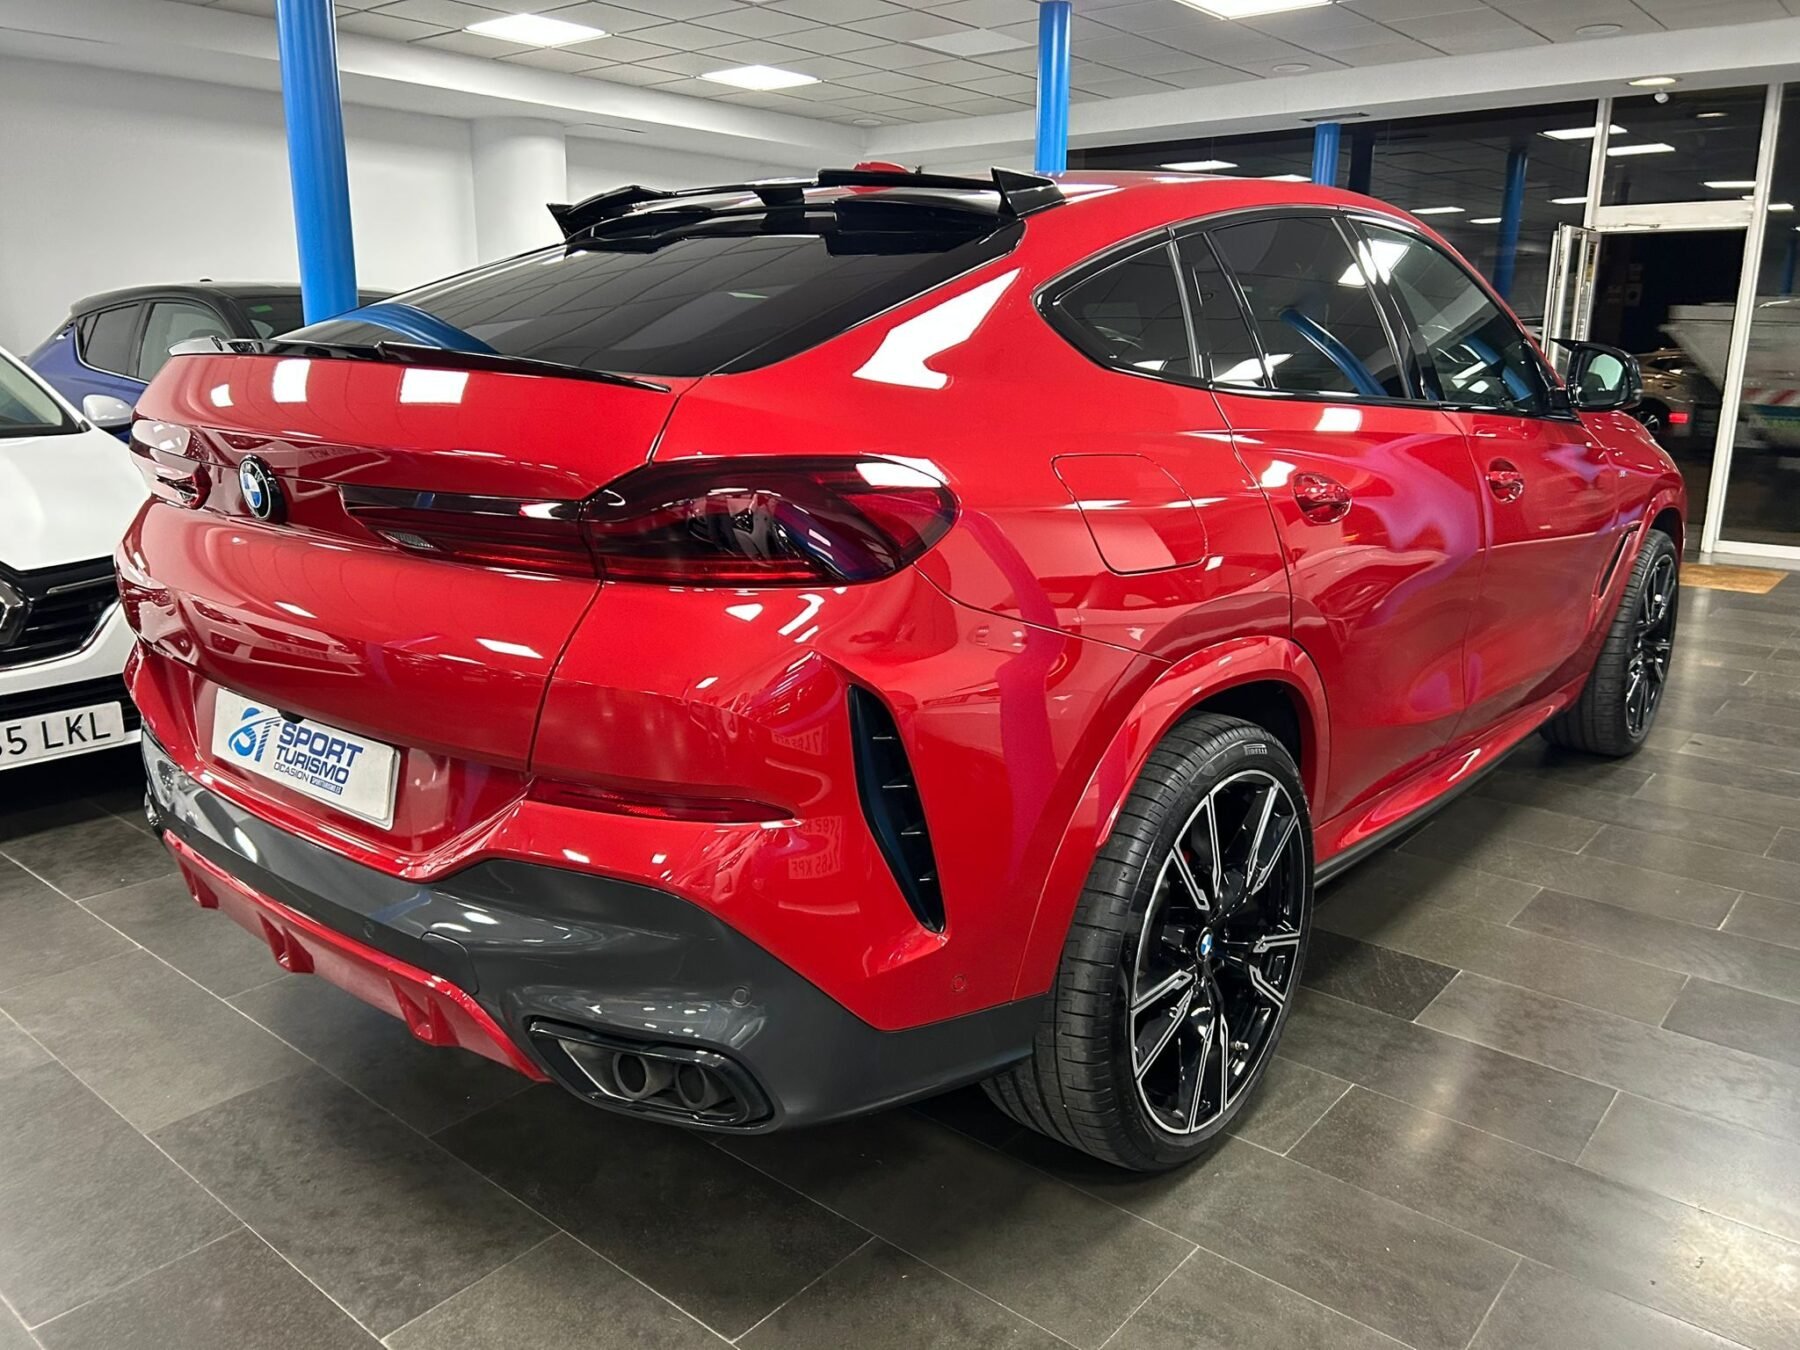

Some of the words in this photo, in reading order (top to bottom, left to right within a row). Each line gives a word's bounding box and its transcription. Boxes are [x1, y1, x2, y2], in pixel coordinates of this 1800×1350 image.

[0, 725, 28, 755] 5
[41, 712, 111, 749] LKL
[279, 722, 364, 767] SPORT
[274, 762, 309, 782] OCASION
[276, 744, 350, 784] TURISMO
